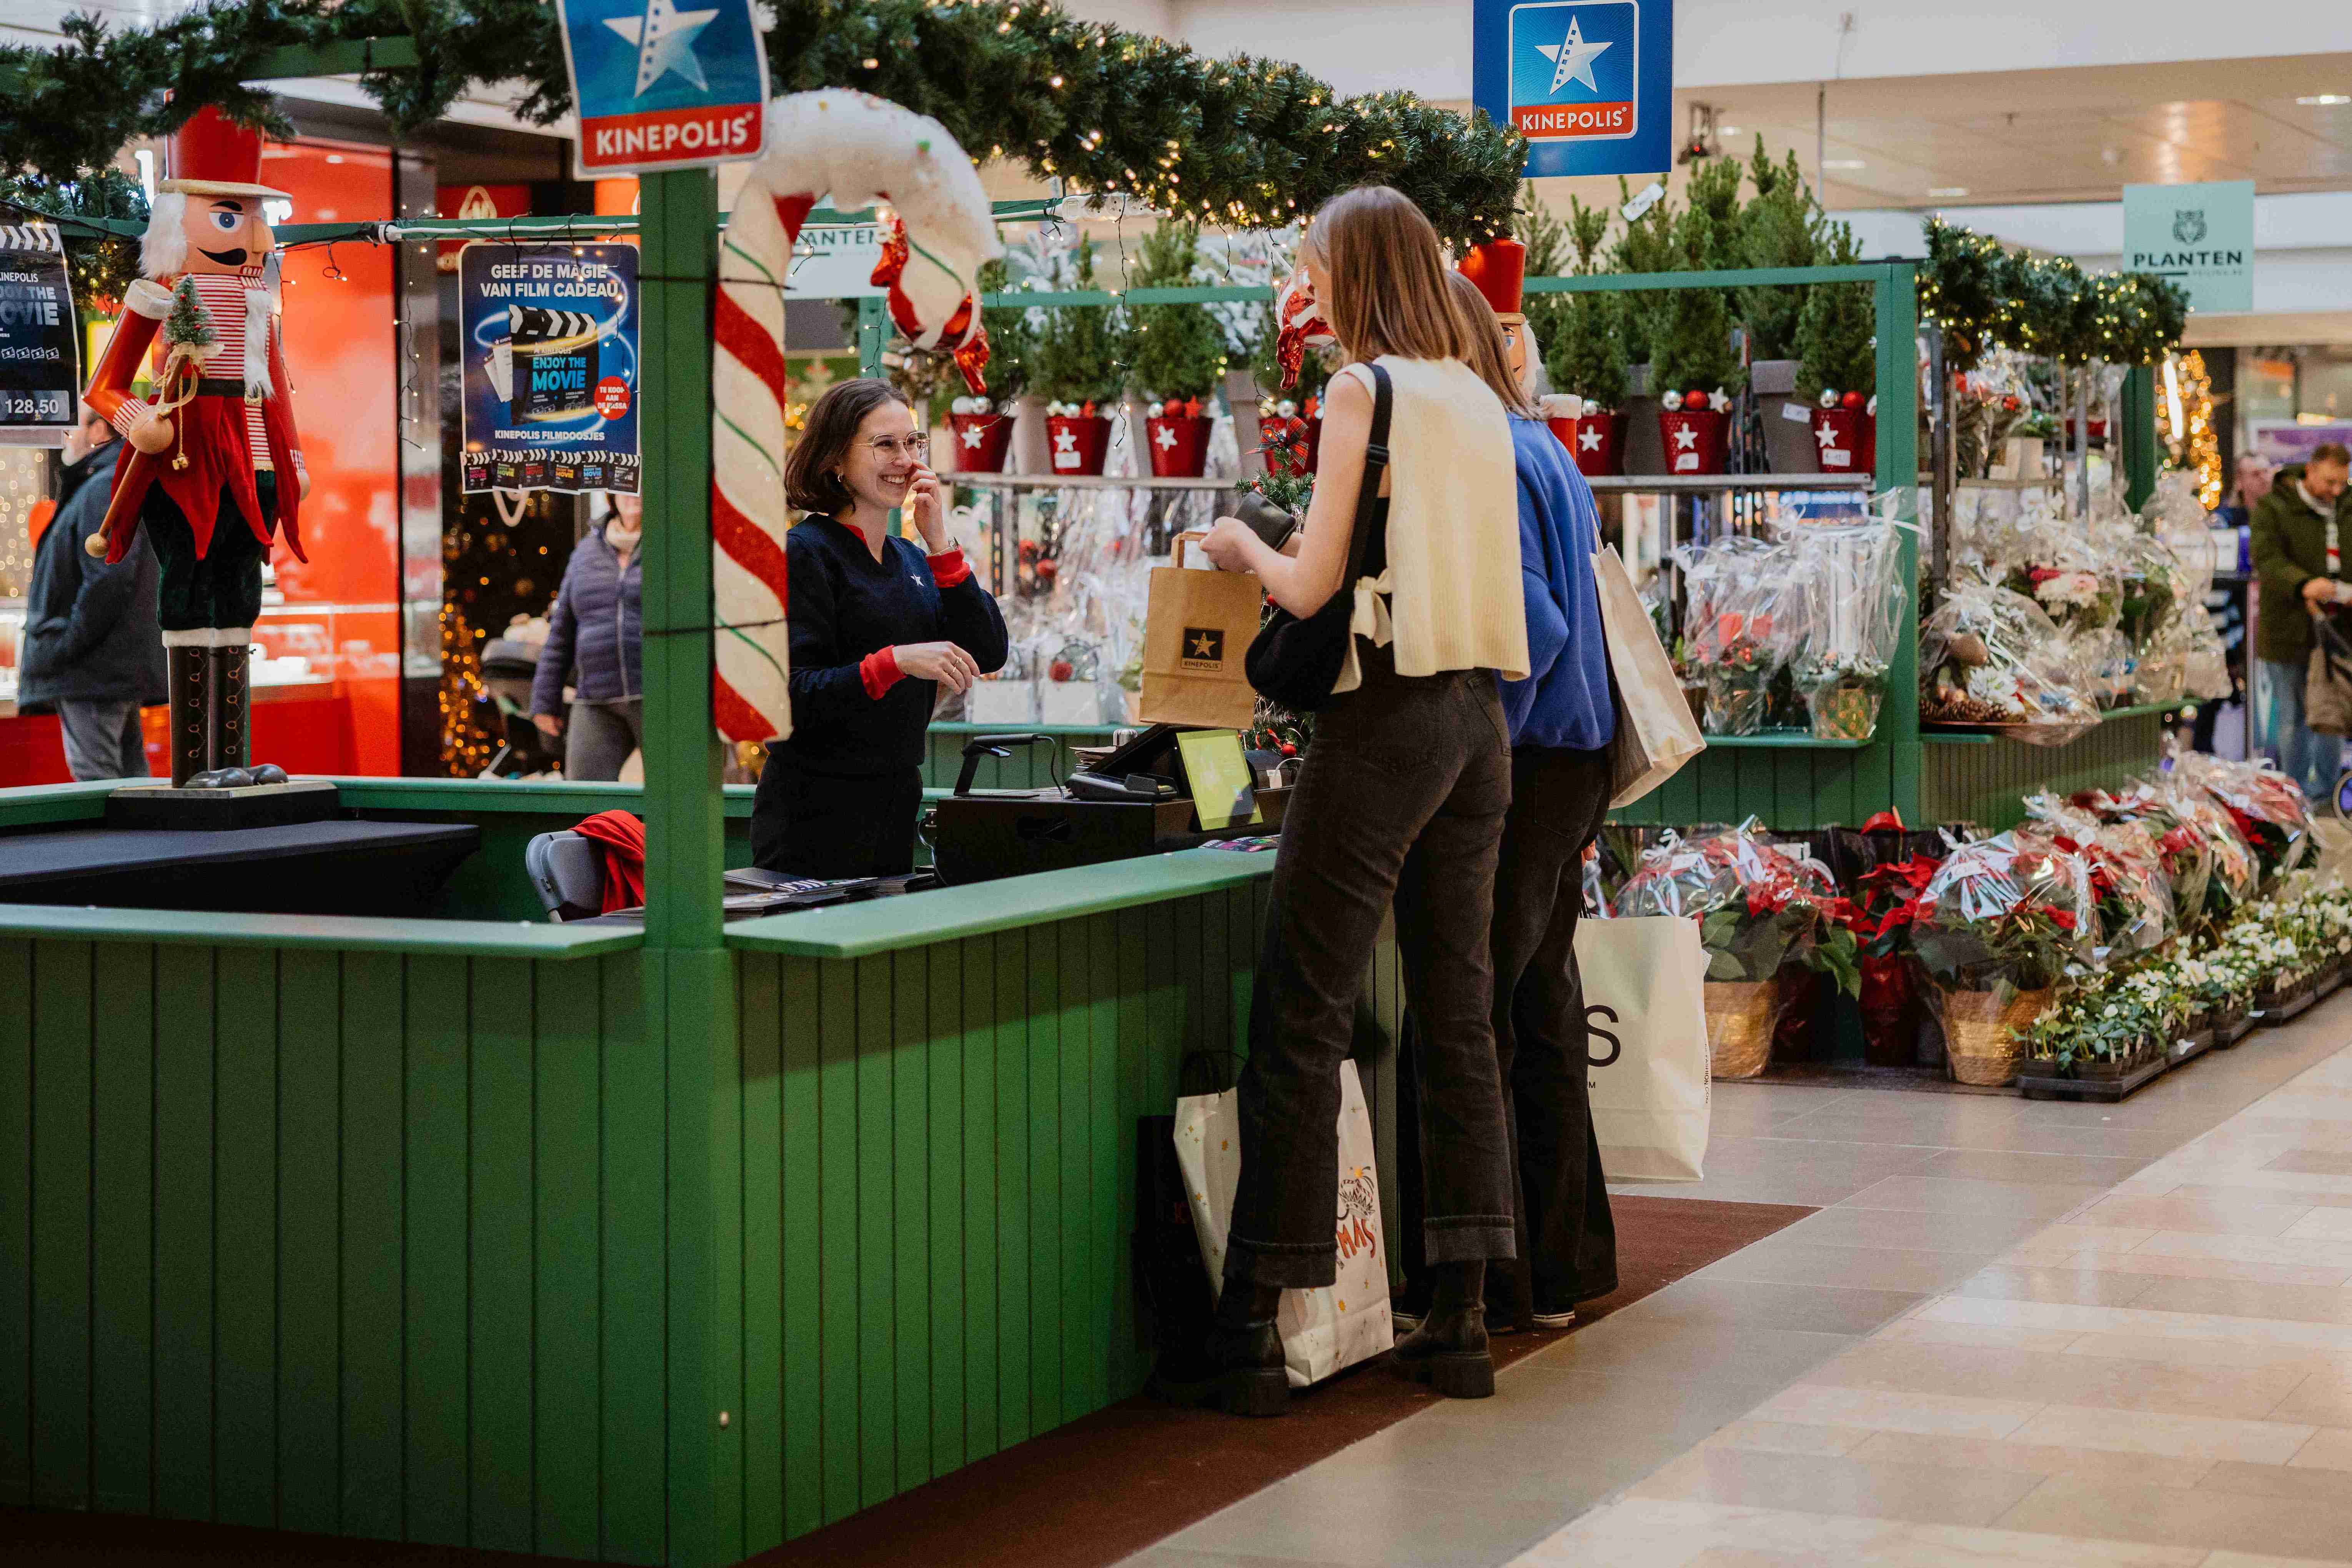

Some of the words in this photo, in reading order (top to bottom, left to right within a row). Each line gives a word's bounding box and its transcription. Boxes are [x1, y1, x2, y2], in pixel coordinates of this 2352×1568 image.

[1522, 110, 1623, 130] KINEPOLIS
[596, 117, 748, 156] KINEPOLIS
[795, 230, 874, 245] ANTE
[2134, 251, 2242, 266] PLANTEN
[491, 264, 528, 278] GEEF
[533, 264, 553, 278] DE
[557, 264, 607, 278] MAGIE
[27, 286, 56, 300] THE
[480, 283, 511, 297] VAN
[515, 283, 549, 297] FILM
[554, 283, 618, 297] CADEAU
[533, 357, 566, 369] ENJOY
[568, 356, 586, 368] THE
[532, 370, 586, 391] MOVIE
[495, 430, 540, 439] KINEPOLIS
[541, 431, 605, 441] FILMDOOSJES
[1585, 1004, 1621, 1067] S
[1337, 1215, 1376, 1258] MAS
